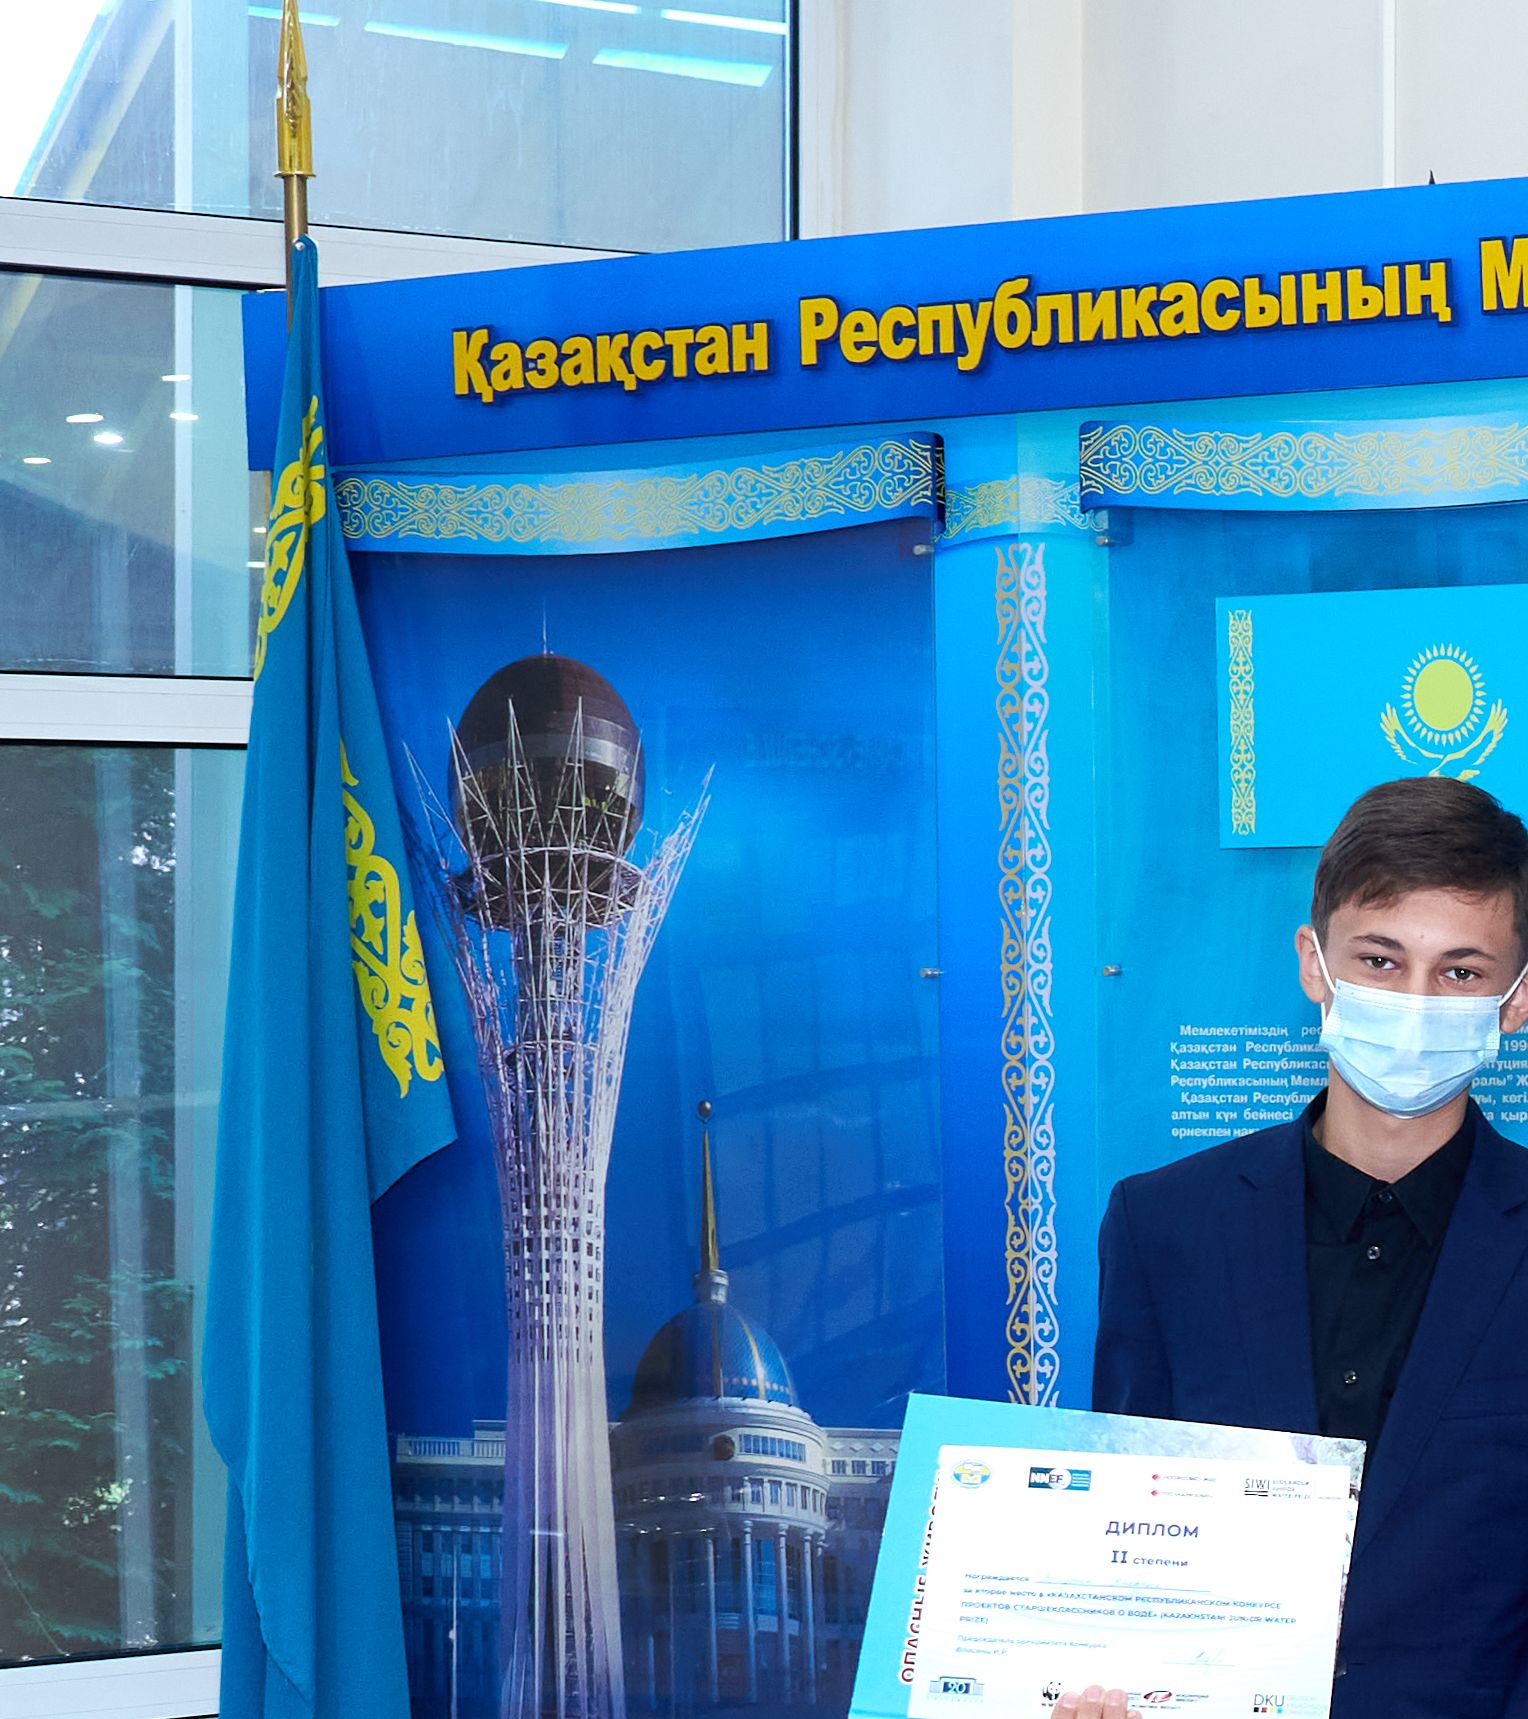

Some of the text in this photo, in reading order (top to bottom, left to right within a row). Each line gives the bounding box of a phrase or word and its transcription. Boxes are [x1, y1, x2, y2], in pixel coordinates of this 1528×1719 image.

[453, 324, 769, 401] Қазақстан
[799, 264, 1452, 368] Республикасының
[1179, 1025, 1289, 1037] Мемлекетіміздің
[1170, 1042, 1238, 1055] Қазақстан
[1170, 1059, 1238, 1072] Қазақстан
[1170, 1074, 1289, 1089] Республикасының
[1180, 1092, 1249, 1105] Қазақстан
[1243, 1107, 1294, 1121] бейнесі
[1105, 1520, 1199, 1538] ДИПЛОМ
[1110, 1550, 1189, 1567] II степени
[1253, 1693, 1286, 1708] DKU
